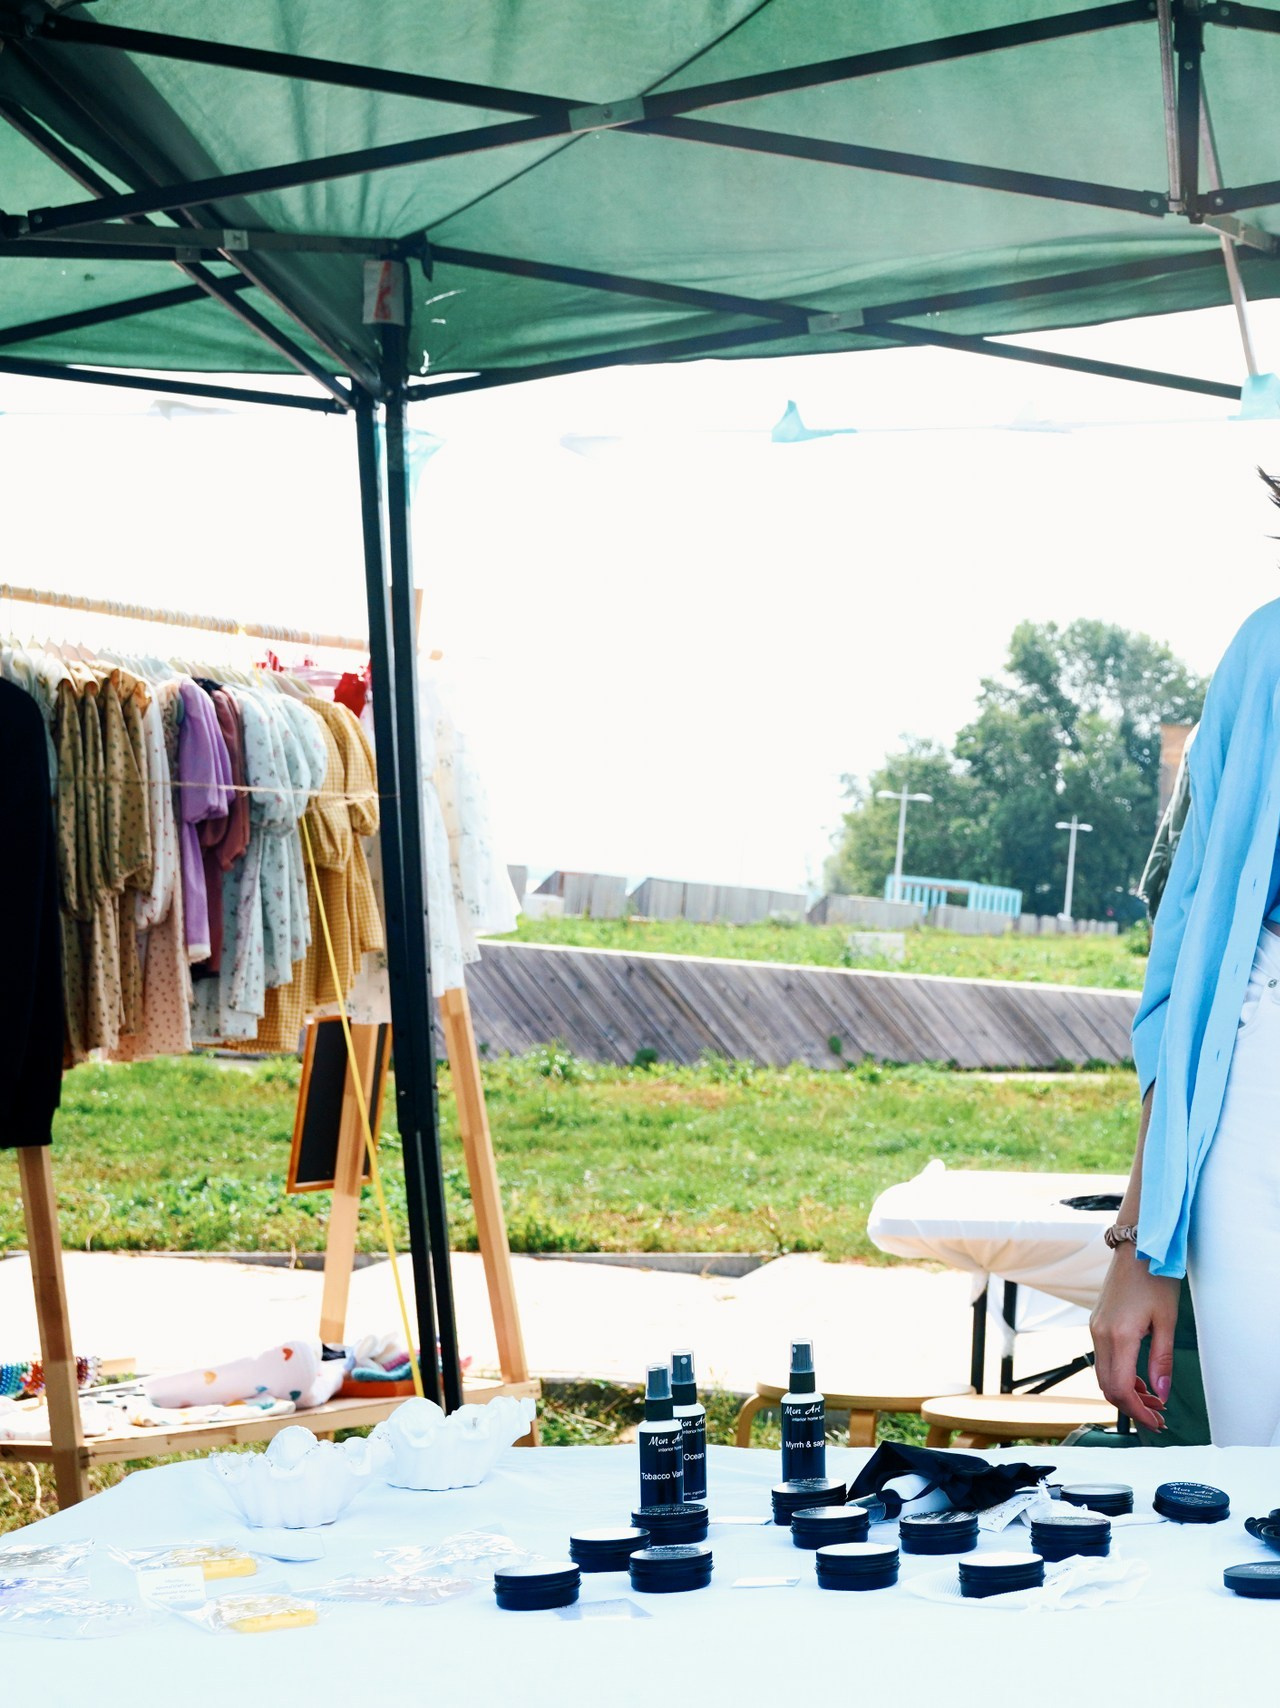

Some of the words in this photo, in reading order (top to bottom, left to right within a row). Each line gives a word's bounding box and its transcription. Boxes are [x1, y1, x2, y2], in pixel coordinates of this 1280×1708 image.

[784, 1406, 801, 1416] Mon
[805, 1404, 821, 1414] Art
[648, 1436, 669, 1446] Mon
[786, 1441, 804, 1450] Myrrh
[684, 1452, 704, 1460] Ocean
